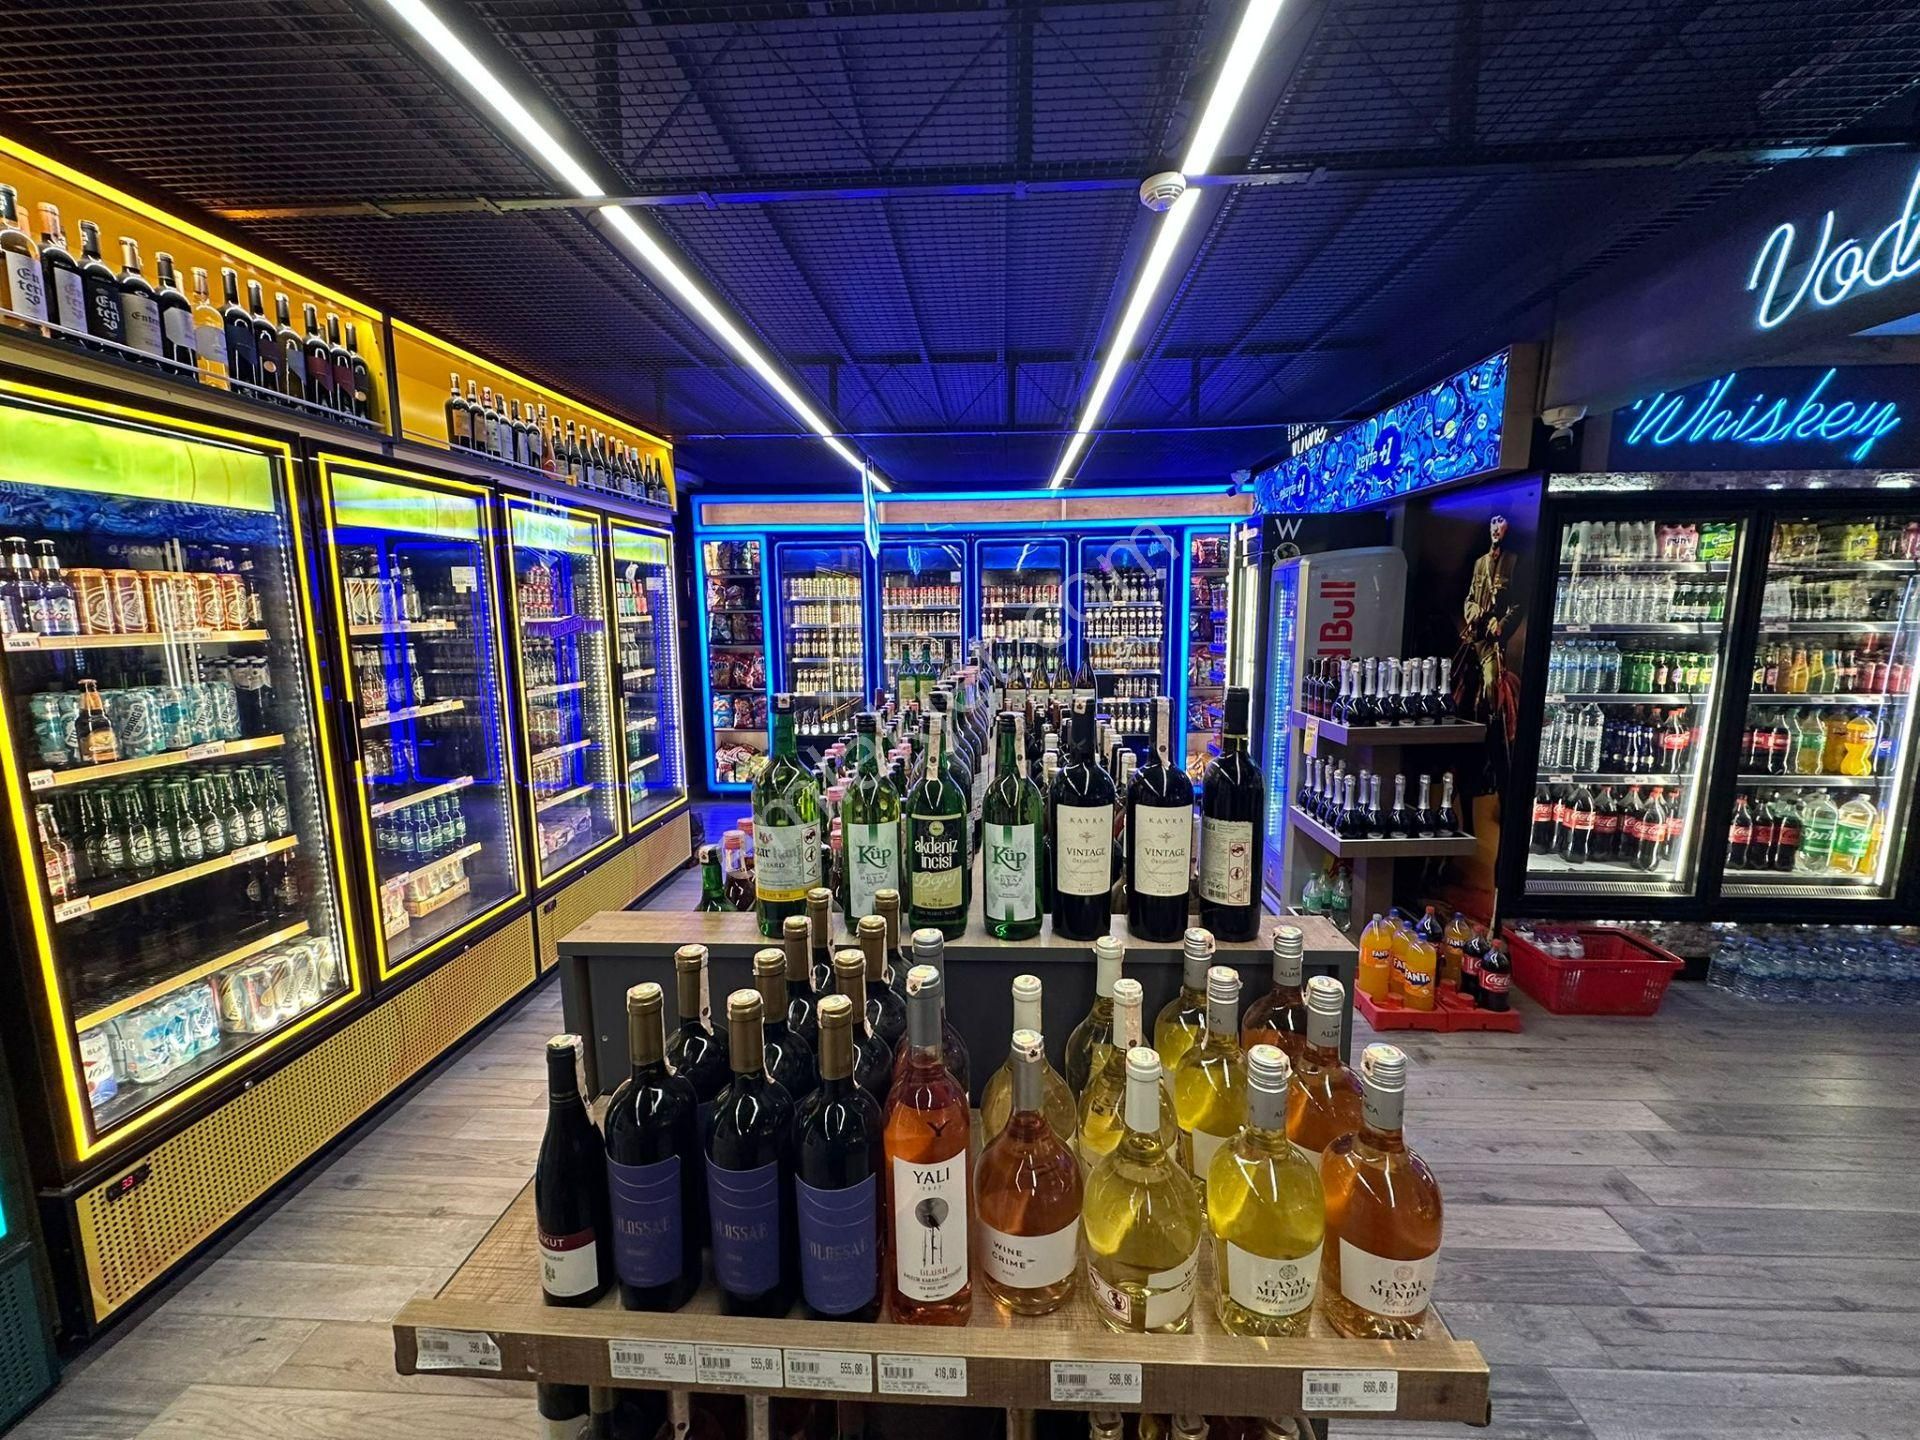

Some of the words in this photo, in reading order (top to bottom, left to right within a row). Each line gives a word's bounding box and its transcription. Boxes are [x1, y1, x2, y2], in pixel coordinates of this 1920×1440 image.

[1746, 170, 1920, 328] Vod
[1626, 367, 1901, 461] Whiskey
[1319, 581, 1356, 642] Bull
[914, 835, 958, 854] akdeniz
[1066, 847, 1106, 857] VINTAGE
[1144, 848, 1185, 857] VINTAGE
[856, 845, 891, 869] Küp
[921, 853, 953, 869] incisi
[991, 845, 1027, 872] Küp
[1405, 968, 1431, 983] FANTA
[913, 1167, 950, 1185] YALI
[993, 1240, 1022, 1257] WINE
[991, 1252, 1027, 1270] CRIME
[1257, 1283, 1310, 1297] MENDES
[1264, 1277, 1305, 1289] CASAL
[1369, 1284, 1427, 1299] MENDES
[1378, 1280, 1422, 1290] CASAL
